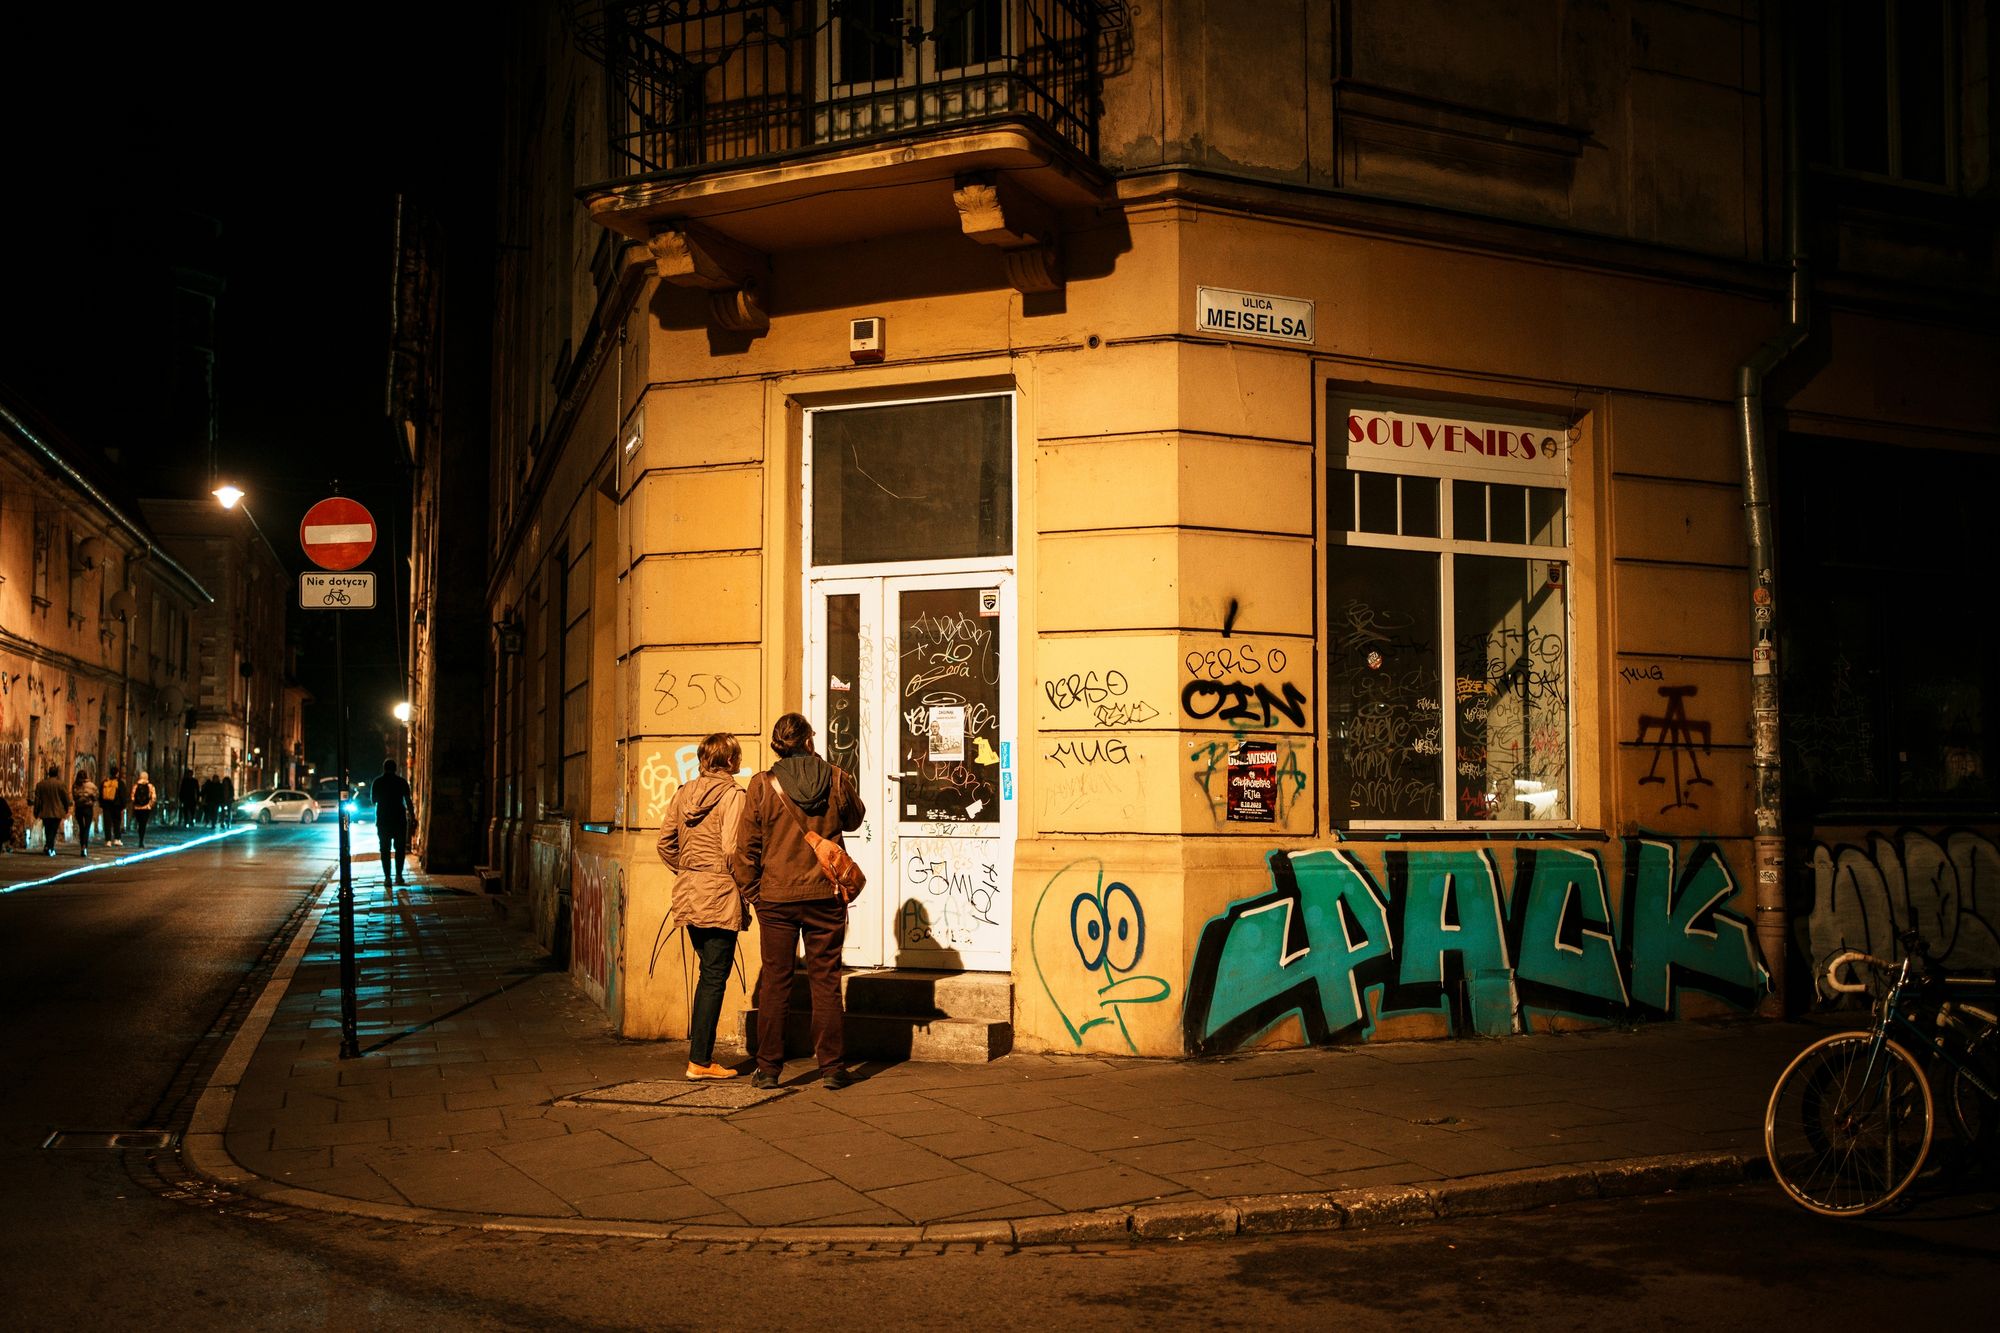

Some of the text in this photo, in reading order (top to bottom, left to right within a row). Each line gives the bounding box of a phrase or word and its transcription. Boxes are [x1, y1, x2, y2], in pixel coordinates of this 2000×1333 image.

[1242, 297, 1273, 311] ULICA
[1207, 308, 1307, 337] MEISELSA
[1347, 415, 1537, 460] SOUVENIRS
[306, 577, 368, 588] Nie dotyczy
